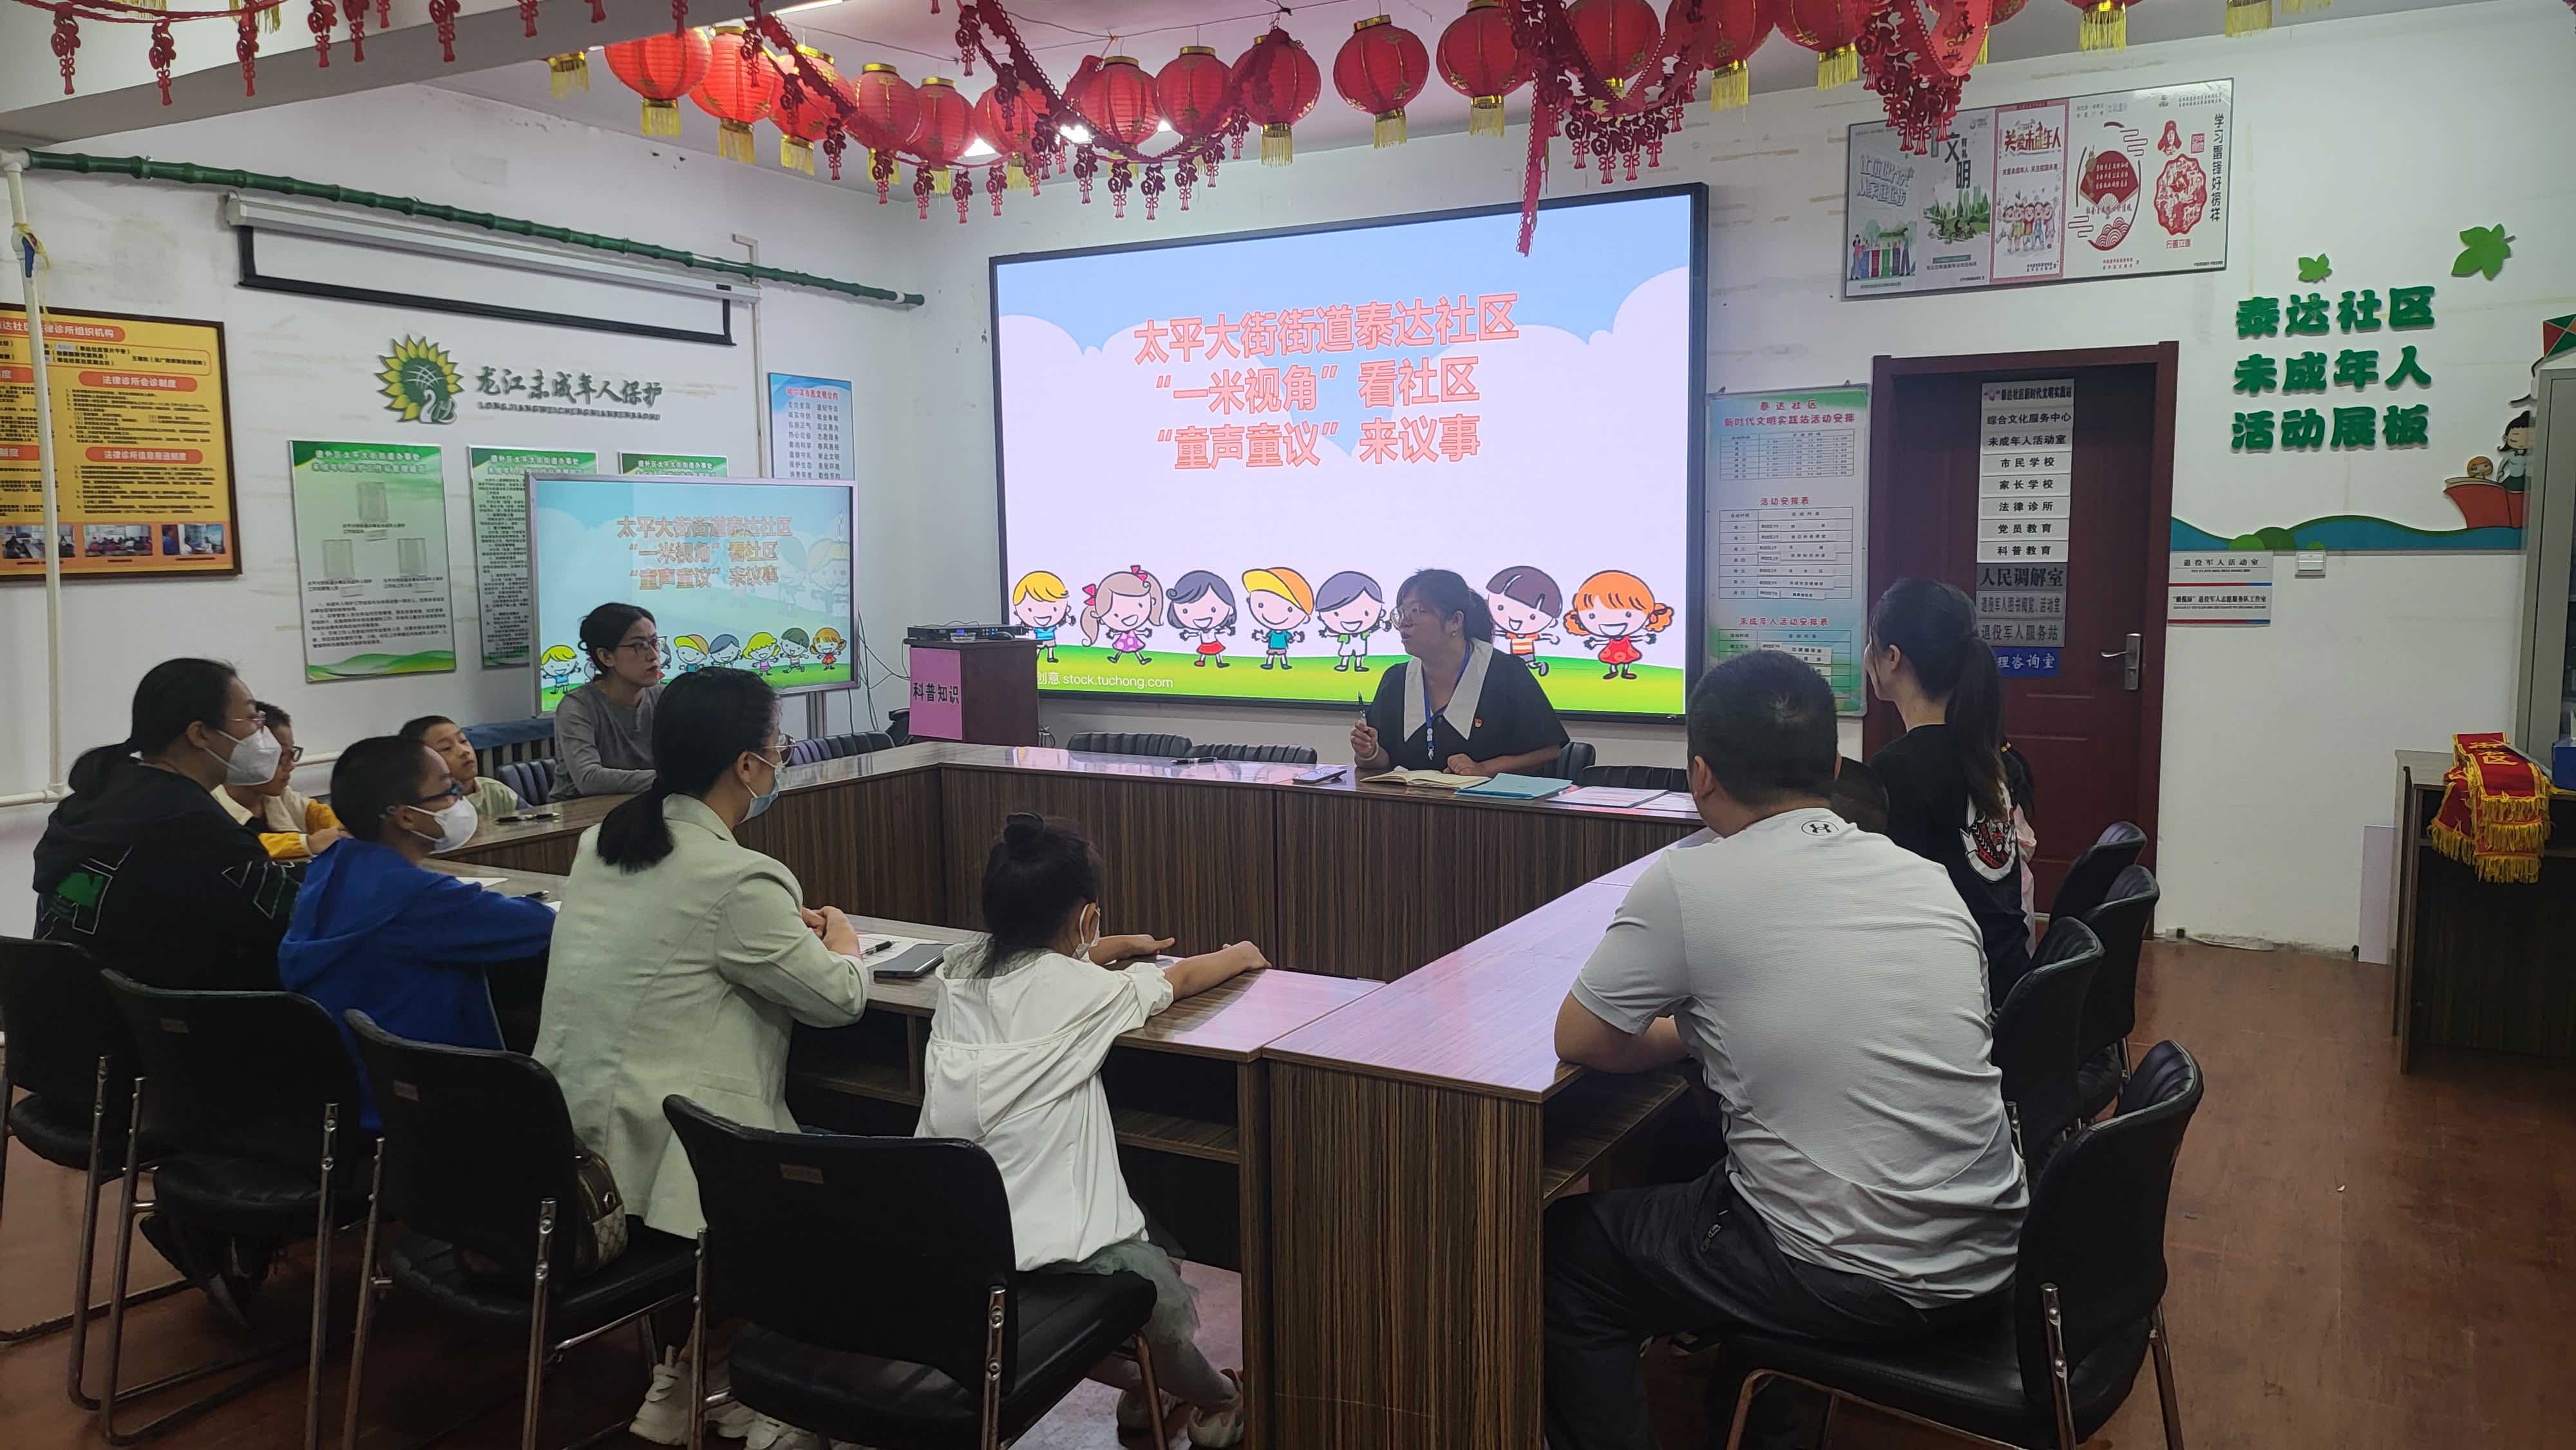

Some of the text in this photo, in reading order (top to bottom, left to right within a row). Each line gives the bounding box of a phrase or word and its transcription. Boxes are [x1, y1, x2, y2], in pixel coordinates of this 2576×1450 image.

[2210, 113, 2224, 222] 学习雷锋好榜样
[2235, 286, 2435, 338] 泰达社区
[1, 321, 114, 338] 达社区律诊所组织机构
[1134, 293, 1519, 364] 太平大街街道泰达社区
[2233, 346, 2432, 396] 未成年人
[476, 365, 663, 408] 龙江未成年人保护
[1760, 400, 1817, 411] 泰达社区
[1724, 413, 1855, 427] 新时代文明实践站活动安排
[1987, 412, 2071, 425] 综合文化服务中心
[2231, 404, 2429, 453] 活动展板
[1989, 435, 2066, 447] 未成年人活动室
[2000, 457, 2055, 468] 市民学校
[1999, 479, 2054, 490] 家长学校
[1761, 496, 1810, 505] 活动安排表
[1999, 502, 2053, 512] 法律诊所
[618, 515, 793, 538] 太平大街街道泰达社区
[1998, 523, 2052, 534] 党员教育
[1997, 545, 2051, 556] 科普教育
[1980, 567, 2063, 587] 人民调解室
[1739, 617, 1828, 626] 未成年人活动安排表
[1981, 624, 2058, 641] 退役军人服务站
[1997, 653, 2055, 669] 理咨询室
[1063, 674, 1174, 690] stock.tuchong.com
[913, 682, 960, 704] 科普知识
